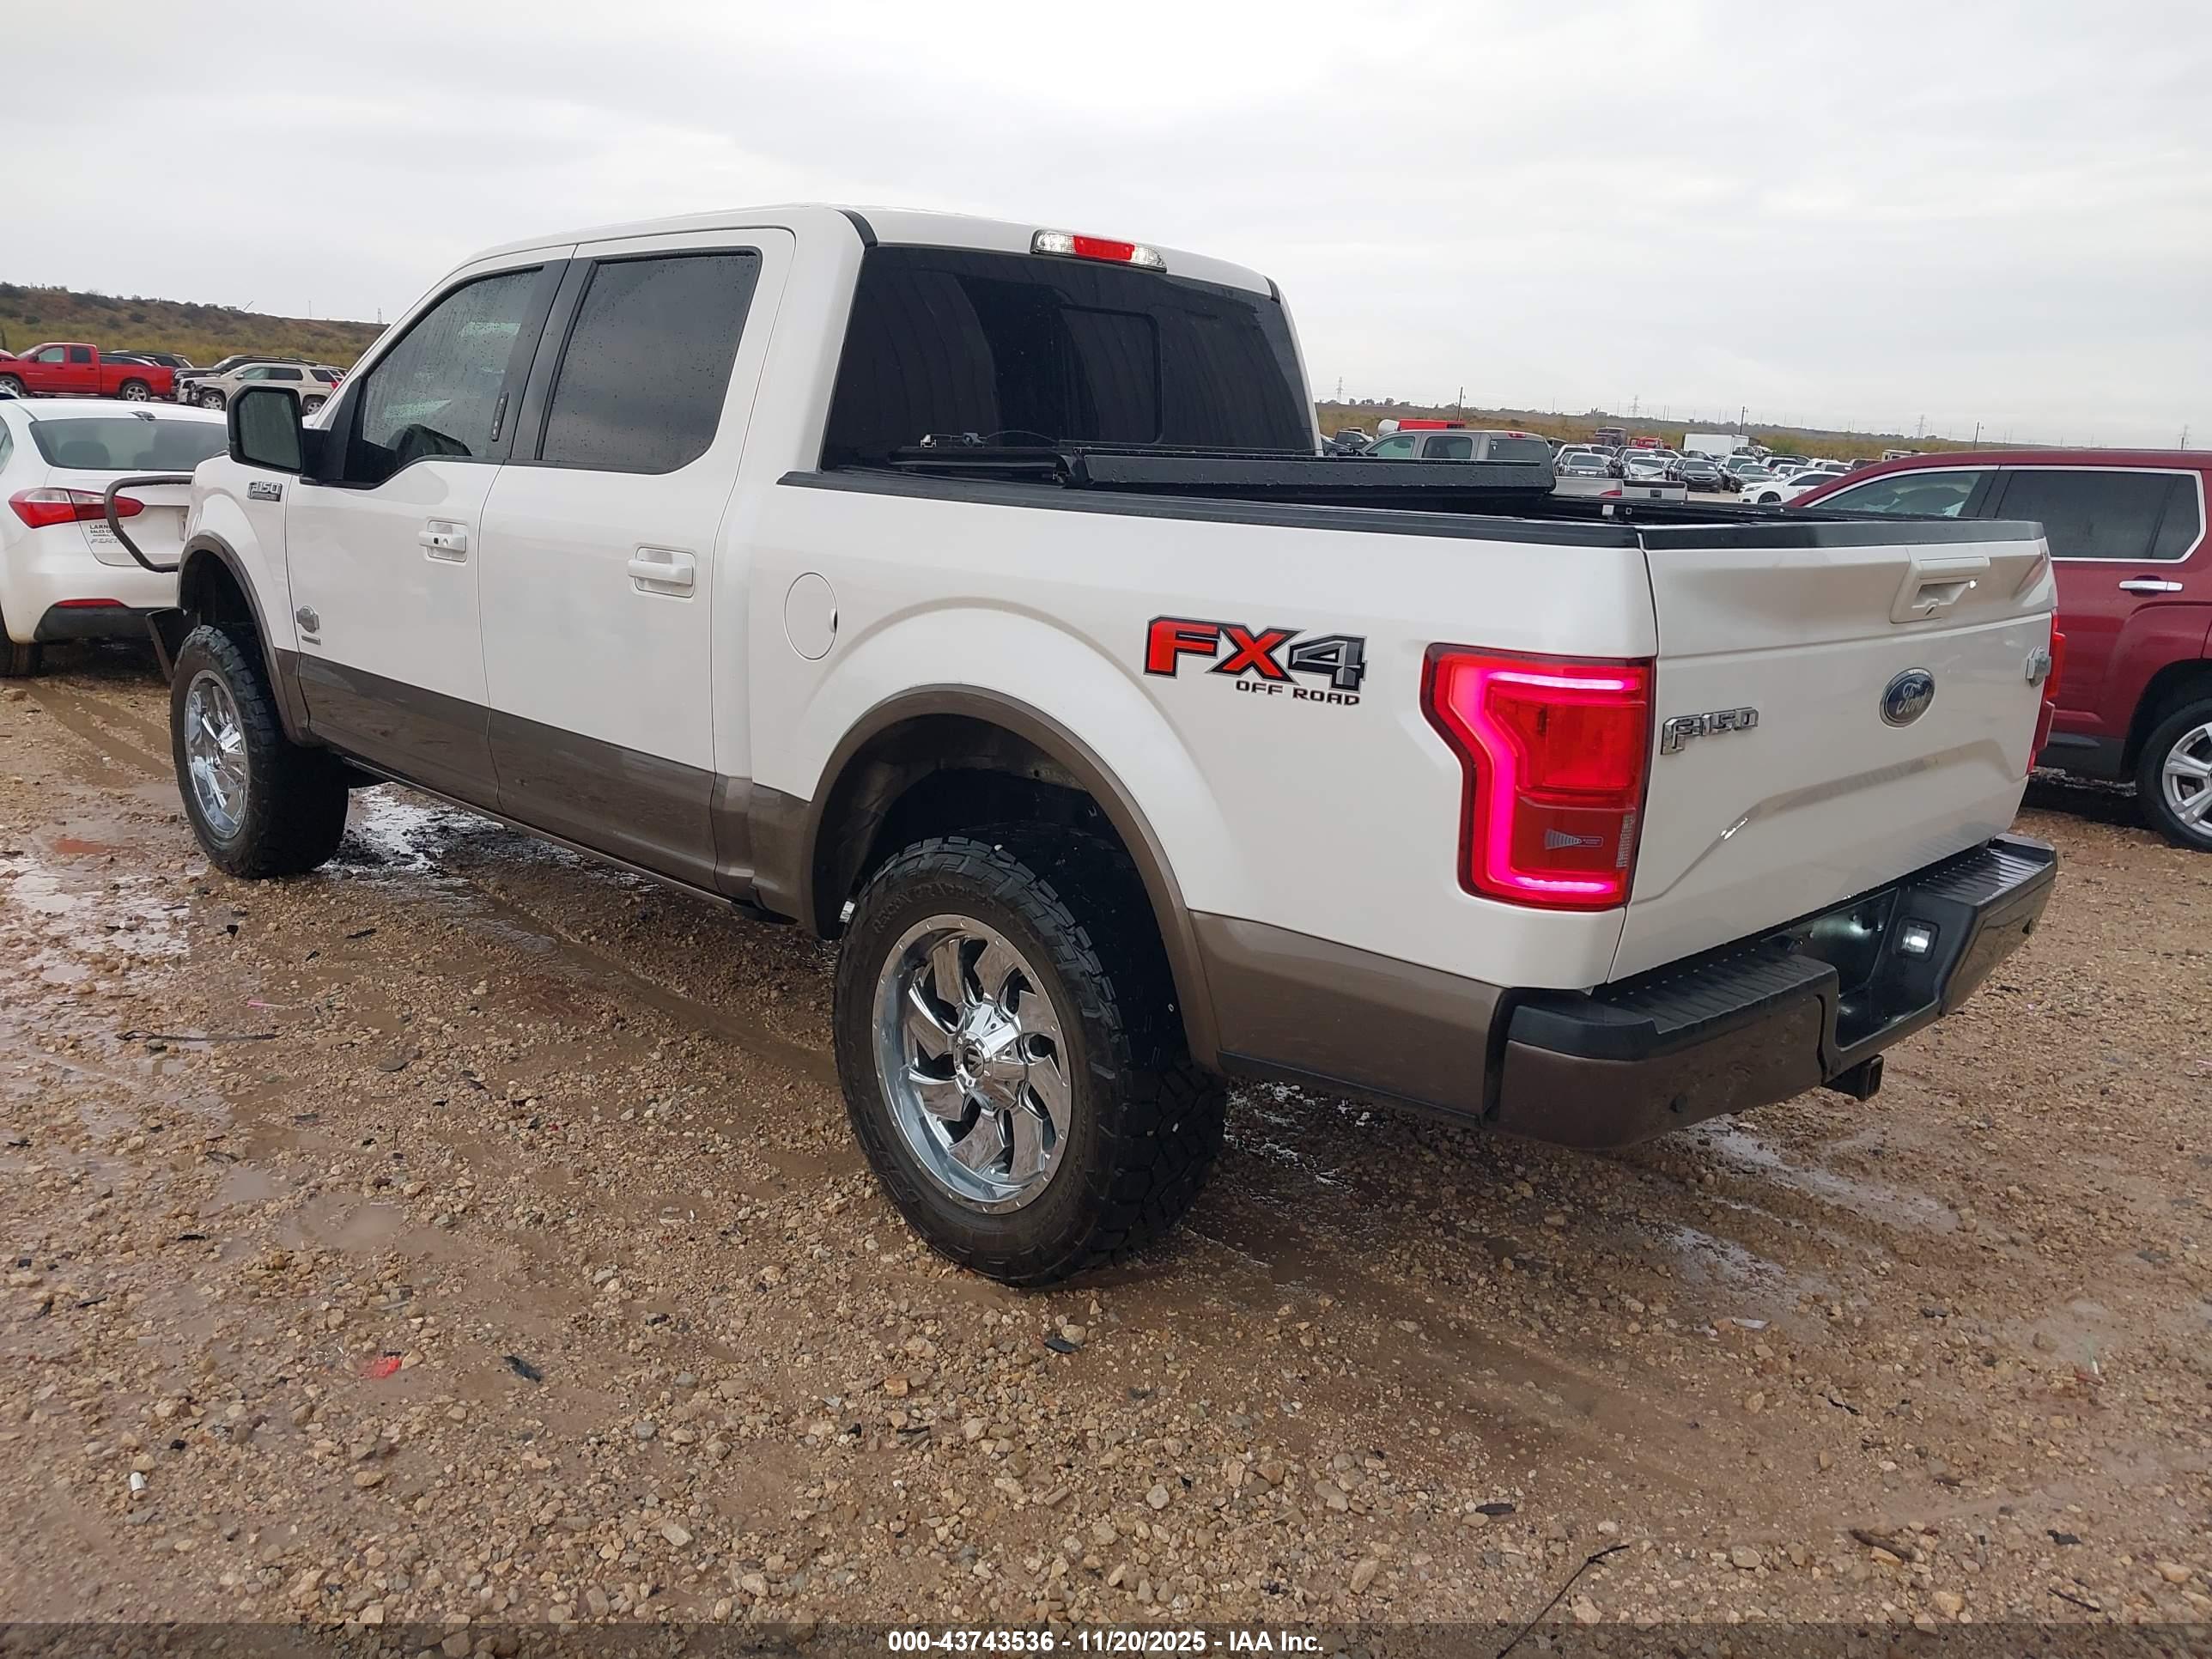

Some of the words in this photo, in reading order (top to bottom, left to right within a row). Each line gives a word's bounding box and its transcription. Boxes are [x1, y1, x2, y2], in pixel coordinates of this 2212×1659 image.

[1144, 615, 1367, 693] FX4
[1236, 680, 1283, 695] OFF
[1292, 688, 1360, 706] ROAD
